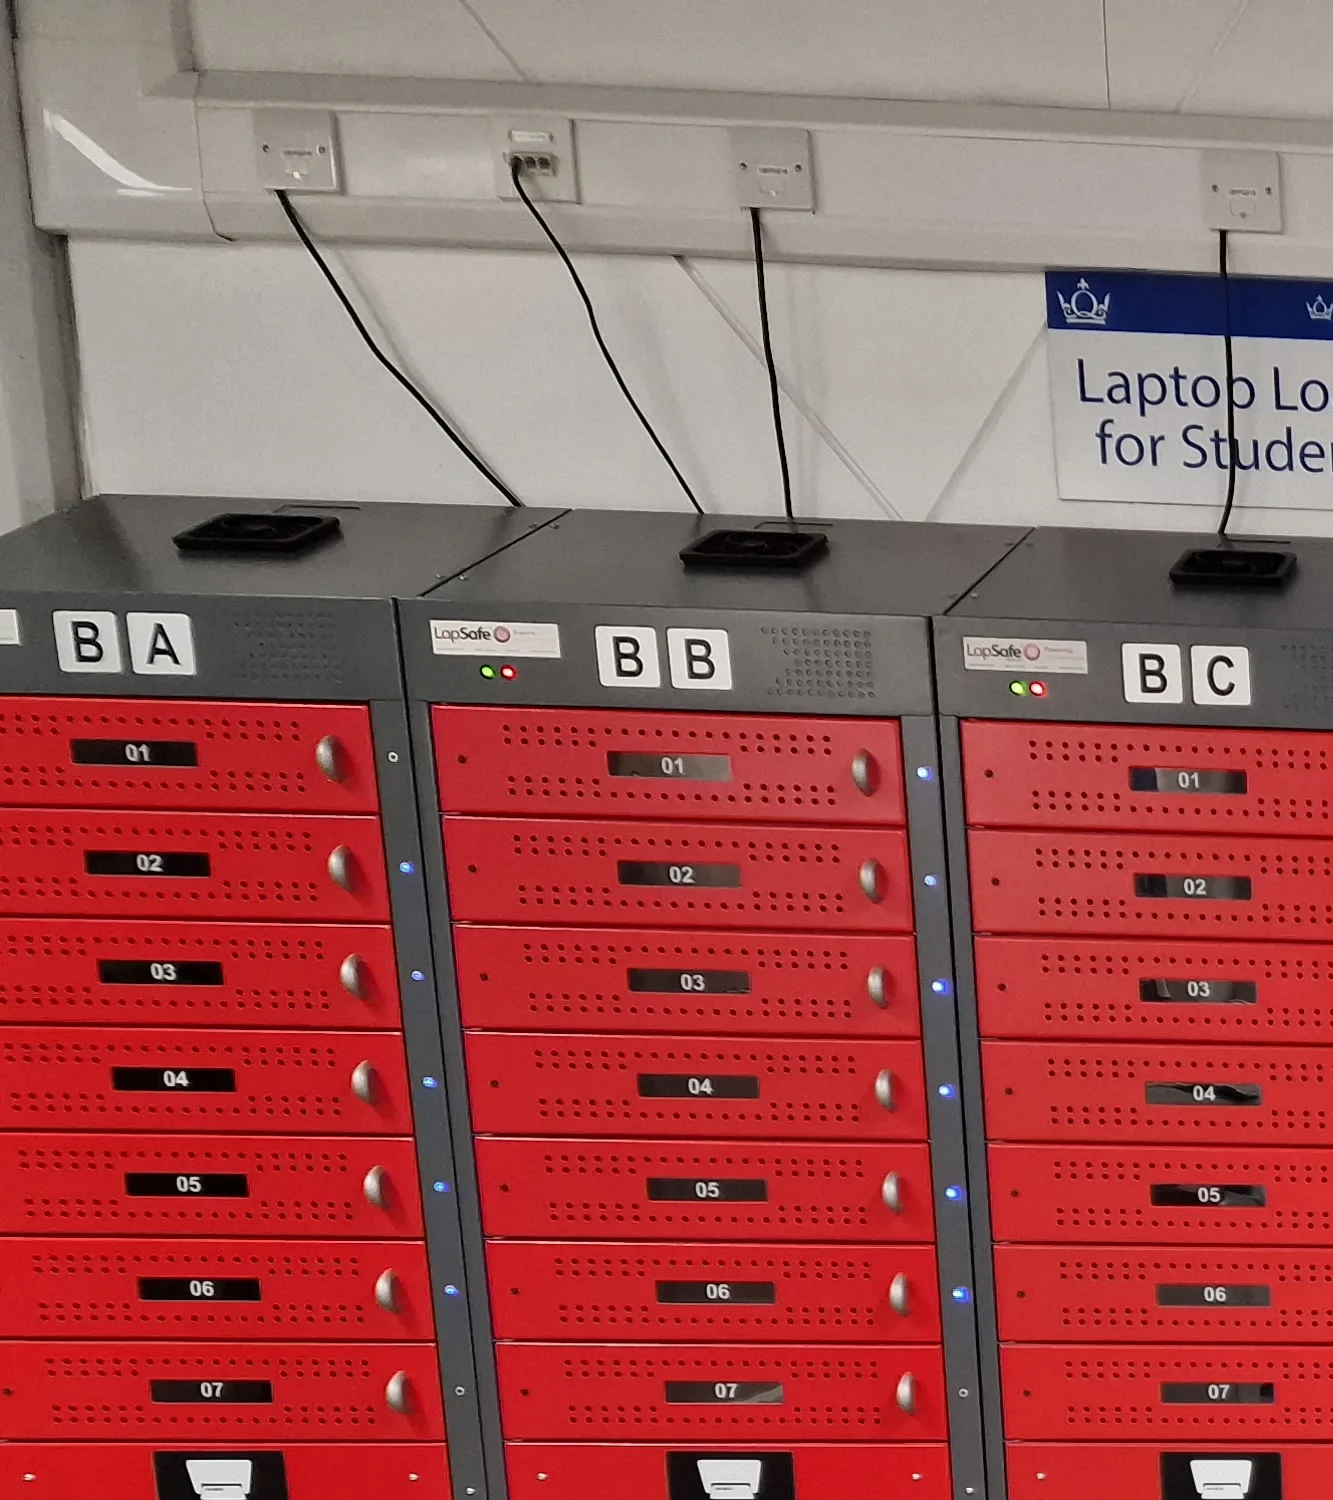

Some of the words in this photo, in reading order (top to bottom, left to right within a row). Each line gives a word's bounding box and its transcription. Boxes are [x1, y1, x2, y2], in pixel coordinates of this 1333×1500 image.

[1077, 357, 1256, 418] Laptop
[1095, 418, 1166, 467] for
[434, 626, 492, 643] LapSafe
[966, 643, 1023, 660] LapSafe
[125, 743, 150, 762] 01
[661, 756, 684, 775] 01
[1178, 771, 1199, 789] 01
[136, 854, 163, 872] 02
[669, 866, 695, 884] 02
[1183, 878, 1207, 895] 02
[150, 962, 177, 981] 03
[680, 973, 705, 991] 03
[1187, 981, 1211, 998] 03
[163, 1070, 190, 1087] 04
[688, 1077, 714, 1095] 04
[1192, 1085, 1217, 1101] 04
[176, 1175, 202, 1193] 05
[695, 1181, 720, 1198] 05
[1197, 1187, 1221, 1203] 05
[189, 1280, 215, 1297] 06
[706, 1283, 730, 1300] 06
[1203, 1286, 1227, 1302] 06
[200, 1382, 224, 1398] 07
[714, 1383, 738, 1399] 07
[1207, 1384, 1231, 1400] 07
